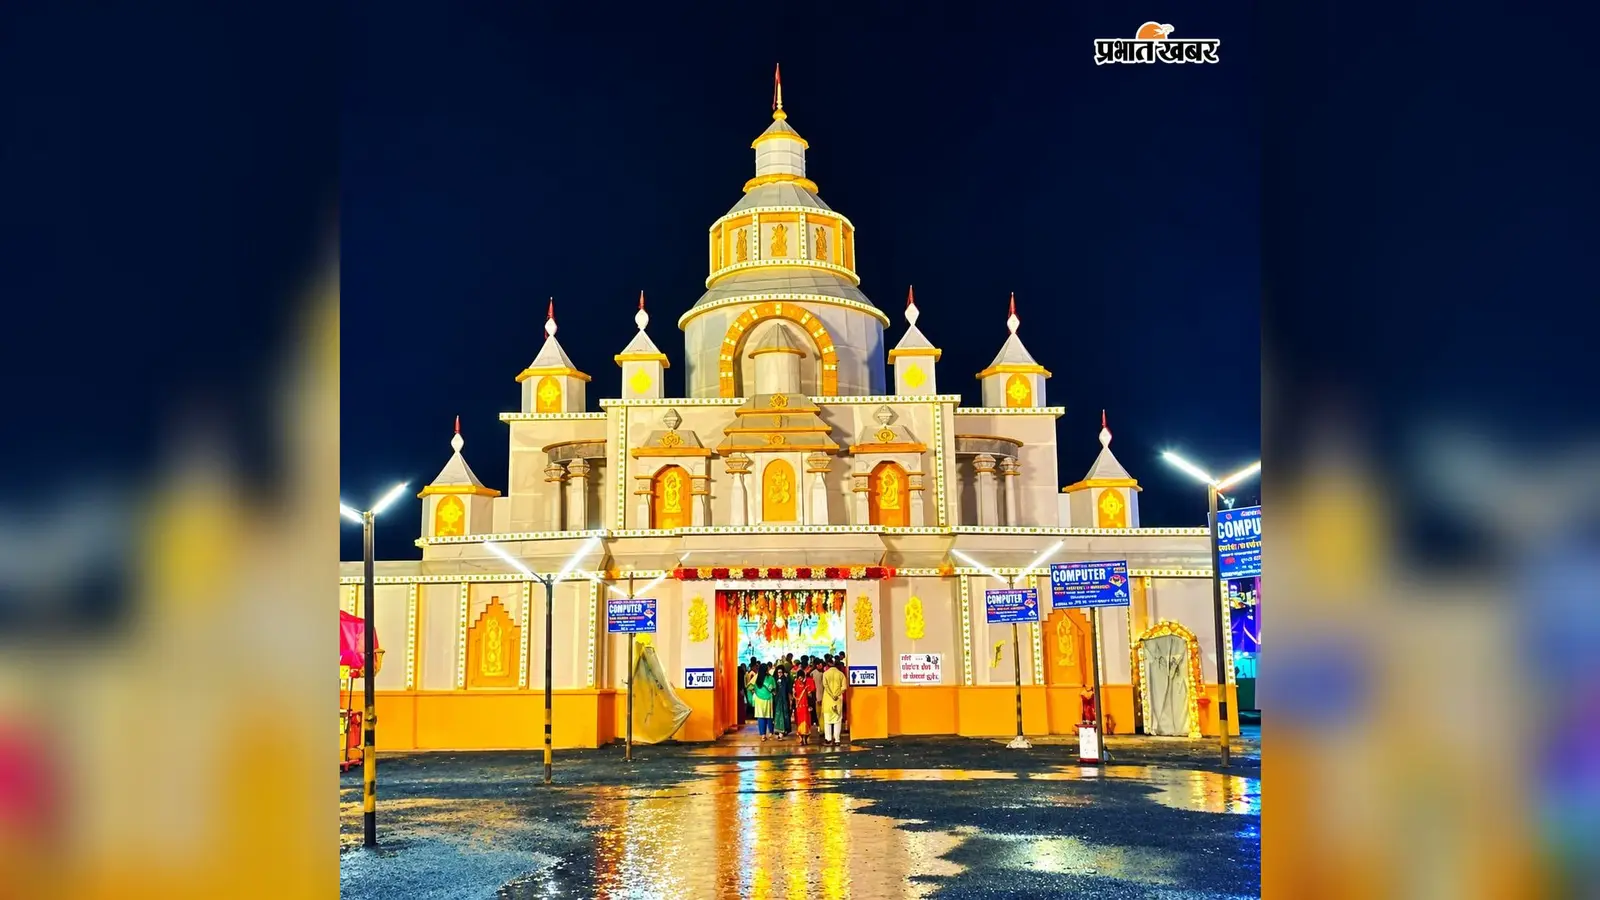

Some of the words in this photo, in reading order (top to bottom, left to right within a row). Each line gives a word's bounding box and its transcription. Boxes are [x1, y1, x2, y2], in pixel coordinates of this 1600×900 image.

[1053, 568, 1106, 582] COMPUTER
[987, 594, 1023, 604] COMPUTER
[609, 604, 643, 614] COMPUTER
